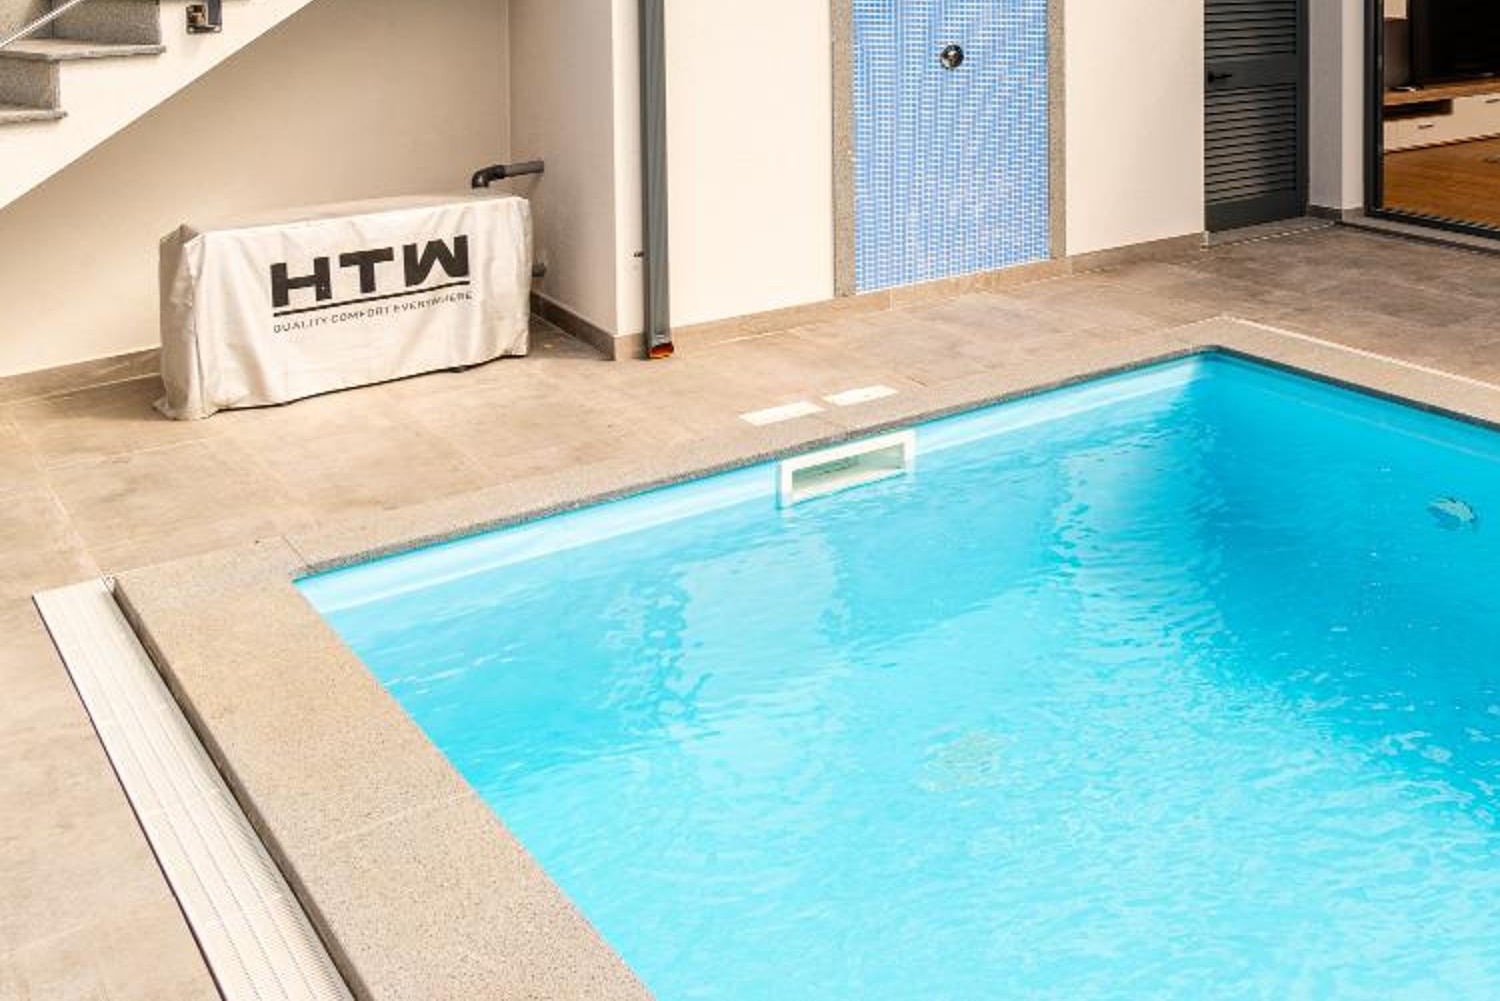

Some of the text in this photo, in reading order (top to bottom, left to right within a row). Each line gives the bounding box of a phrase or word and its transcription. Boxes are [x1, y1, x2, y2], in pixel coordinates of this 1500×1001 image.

[270, 235, 469, 308] HTW
[273, 318, 329, 334] QUALITY
[331, 306, 389, 324] COMFORT
